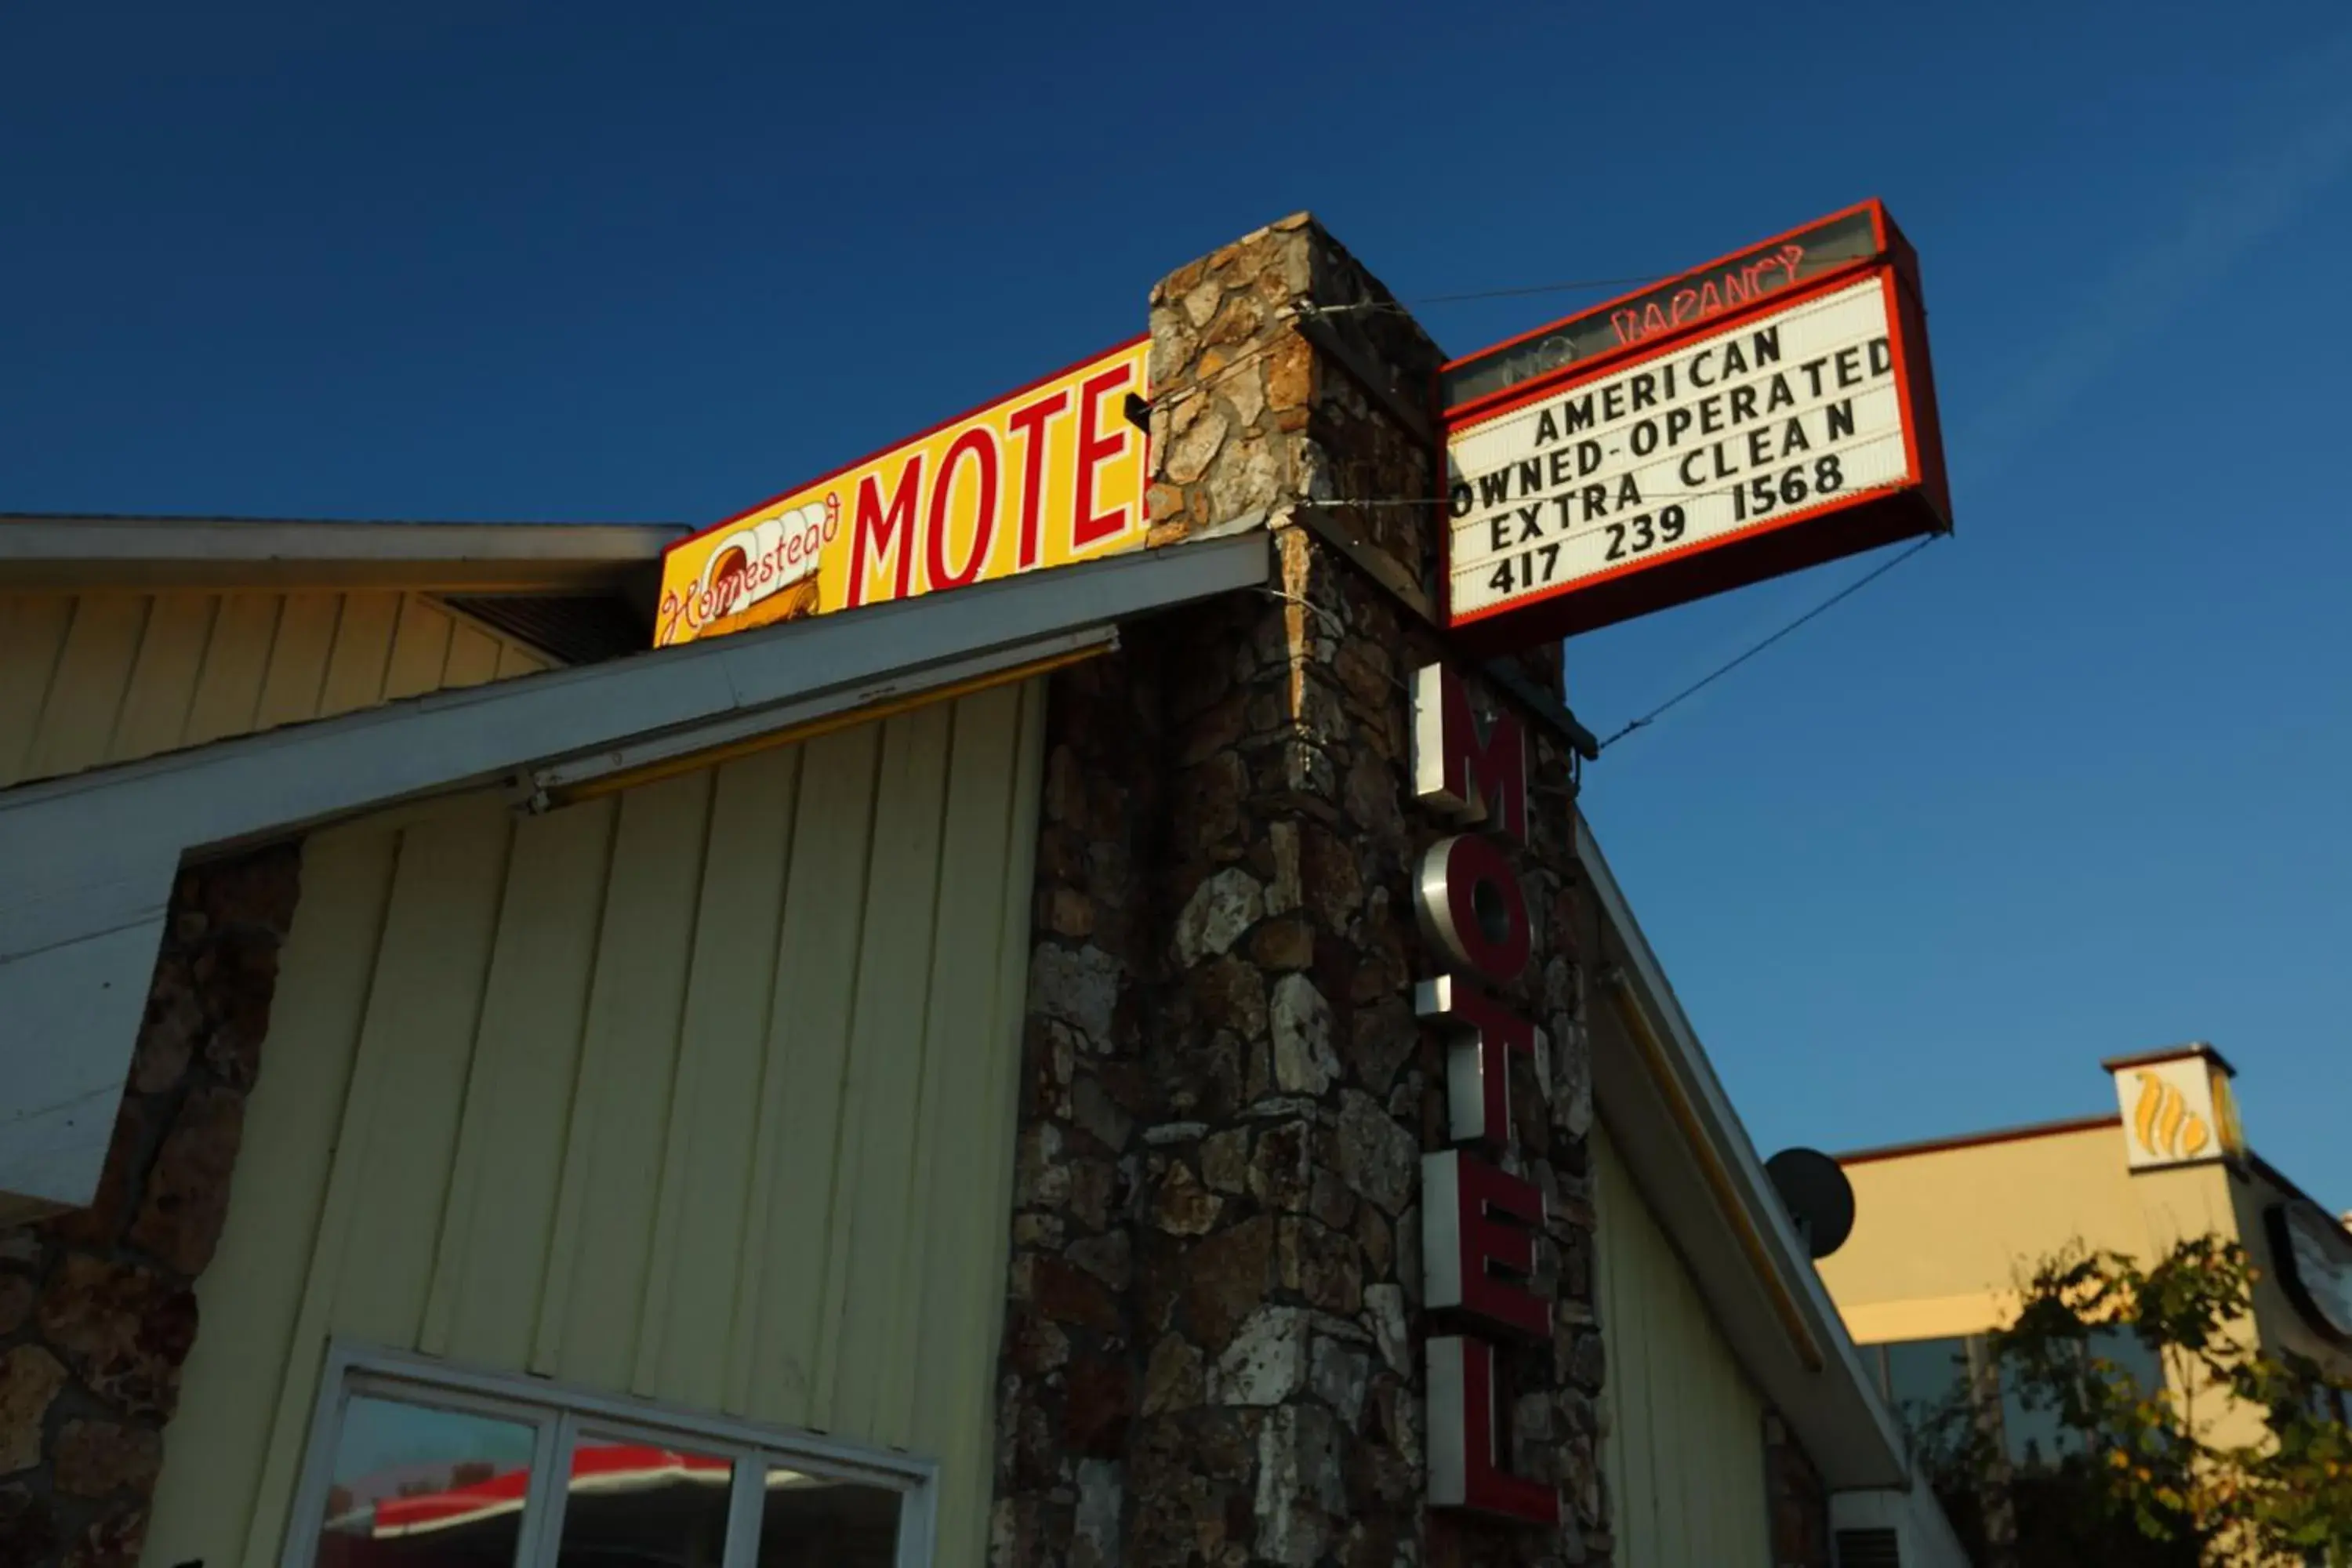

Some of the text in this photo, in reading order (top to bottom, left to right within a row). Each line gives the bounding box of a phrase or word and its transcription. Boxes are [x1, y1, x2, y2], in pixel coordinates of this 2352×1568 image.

[1449, 336, 1893, 518] OWNED-OPERATED
[1534, 325, 1780, 446] AMERICAN
[660, 350, 1152, 646] Homestead MOTE
[1488, 455, 1844, 593] 417 239 1568
[1490, 397, 1855, 551] EXTRA CLEAN
[1414, 662, 1559, 1522] MOTEL
